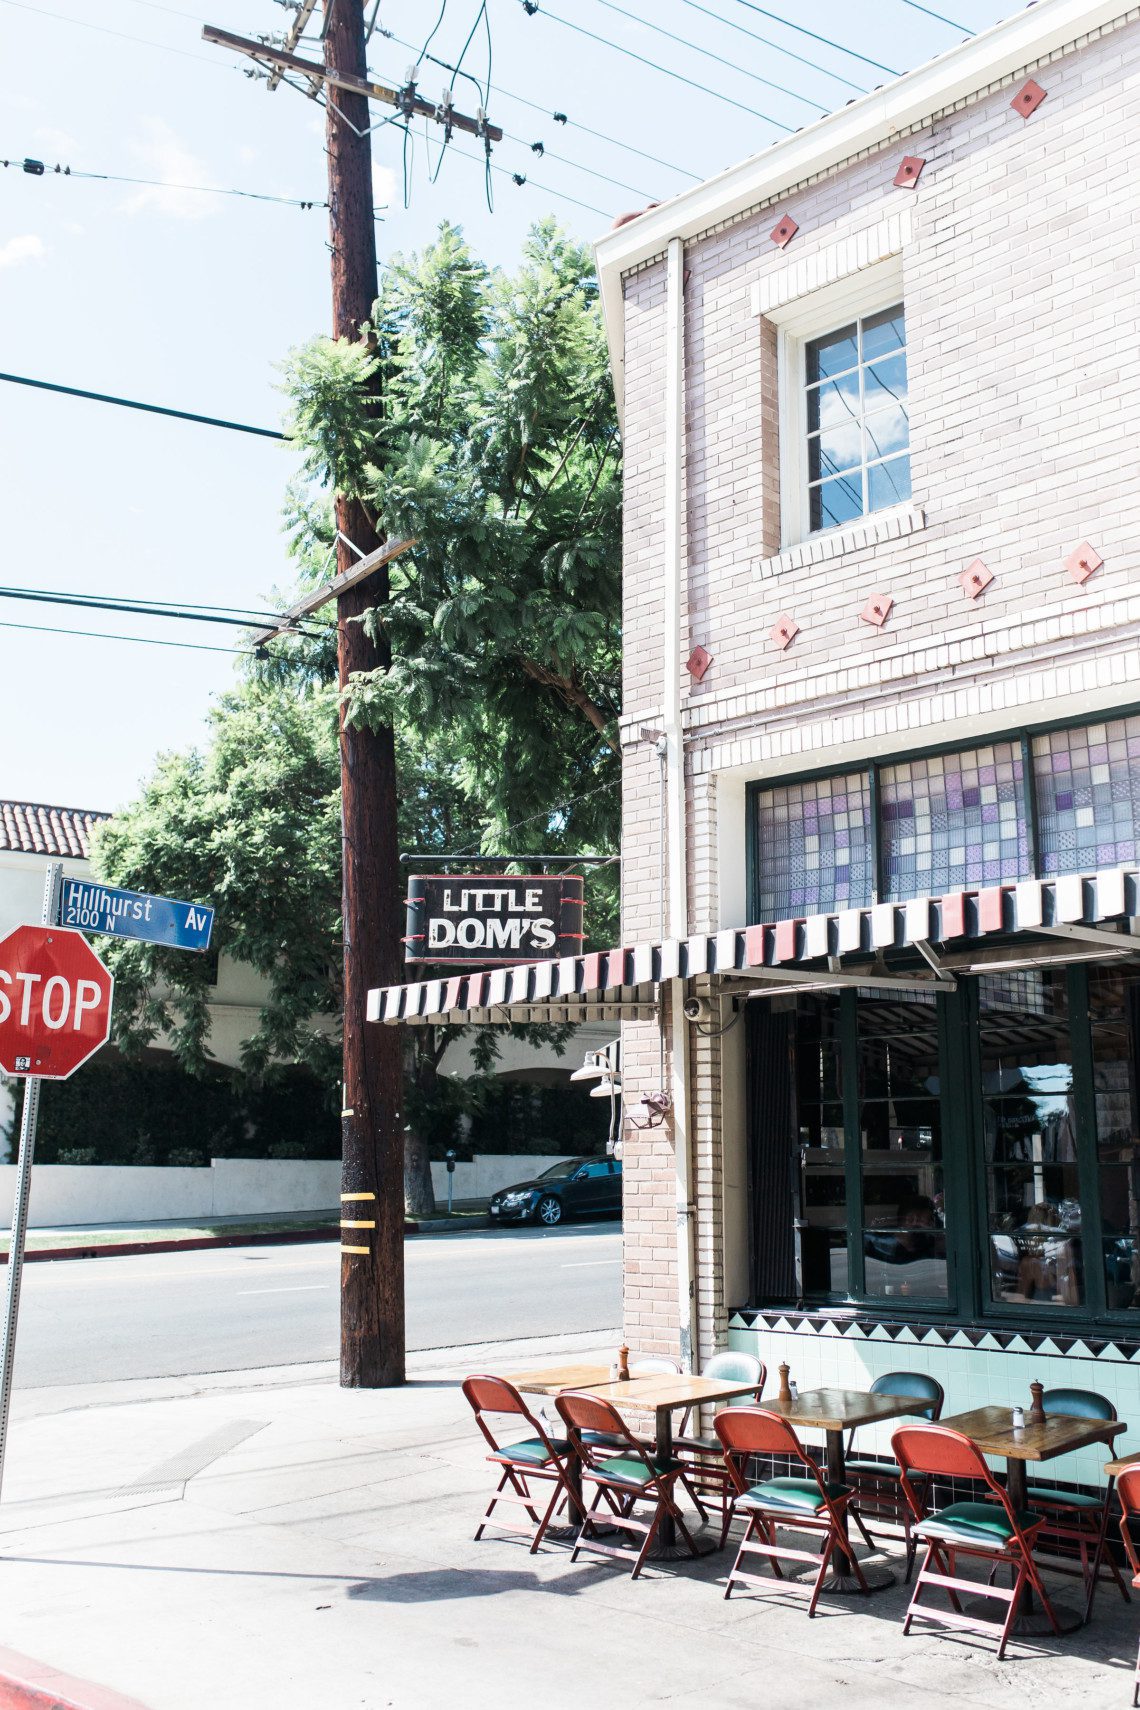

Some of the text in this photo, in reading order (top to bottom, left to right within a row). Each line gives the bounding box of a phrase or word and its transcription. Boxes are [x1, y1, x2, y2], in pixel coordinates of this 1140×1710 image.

[68, 883, 207, 931] Hillhurst Av
[443, 889, 543, 912] LITTLE
[66, 907, 116, 931] 2100 N
[428, 917, 557, 949] DOM'S
